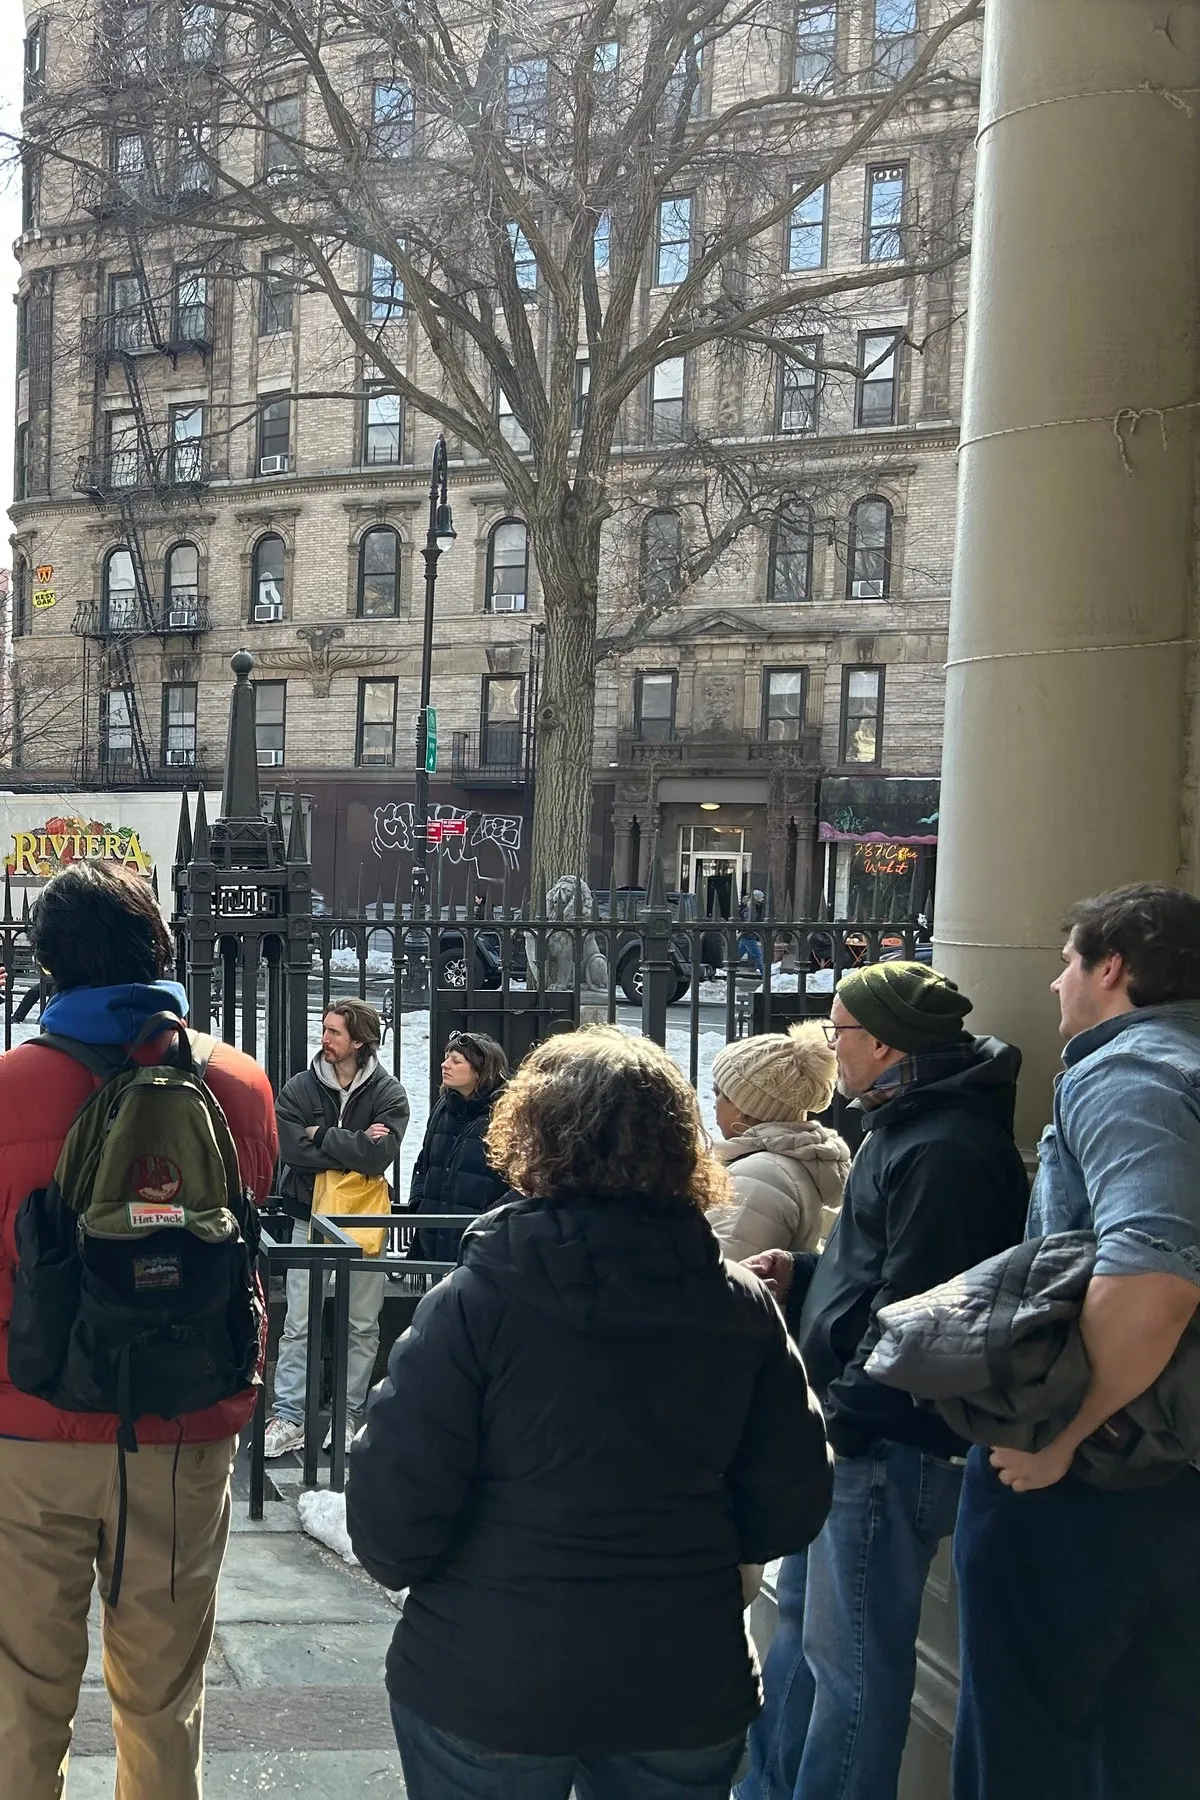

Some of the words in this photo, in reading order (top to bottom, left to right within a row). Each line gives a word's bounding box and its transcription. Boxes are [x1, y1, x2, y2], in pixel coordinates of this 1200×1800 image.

[11, 832, 150, 876] RIVIERA
[133, 1215, 154, 1225] Hat
[155, 1213, 183, 1224] Pack
